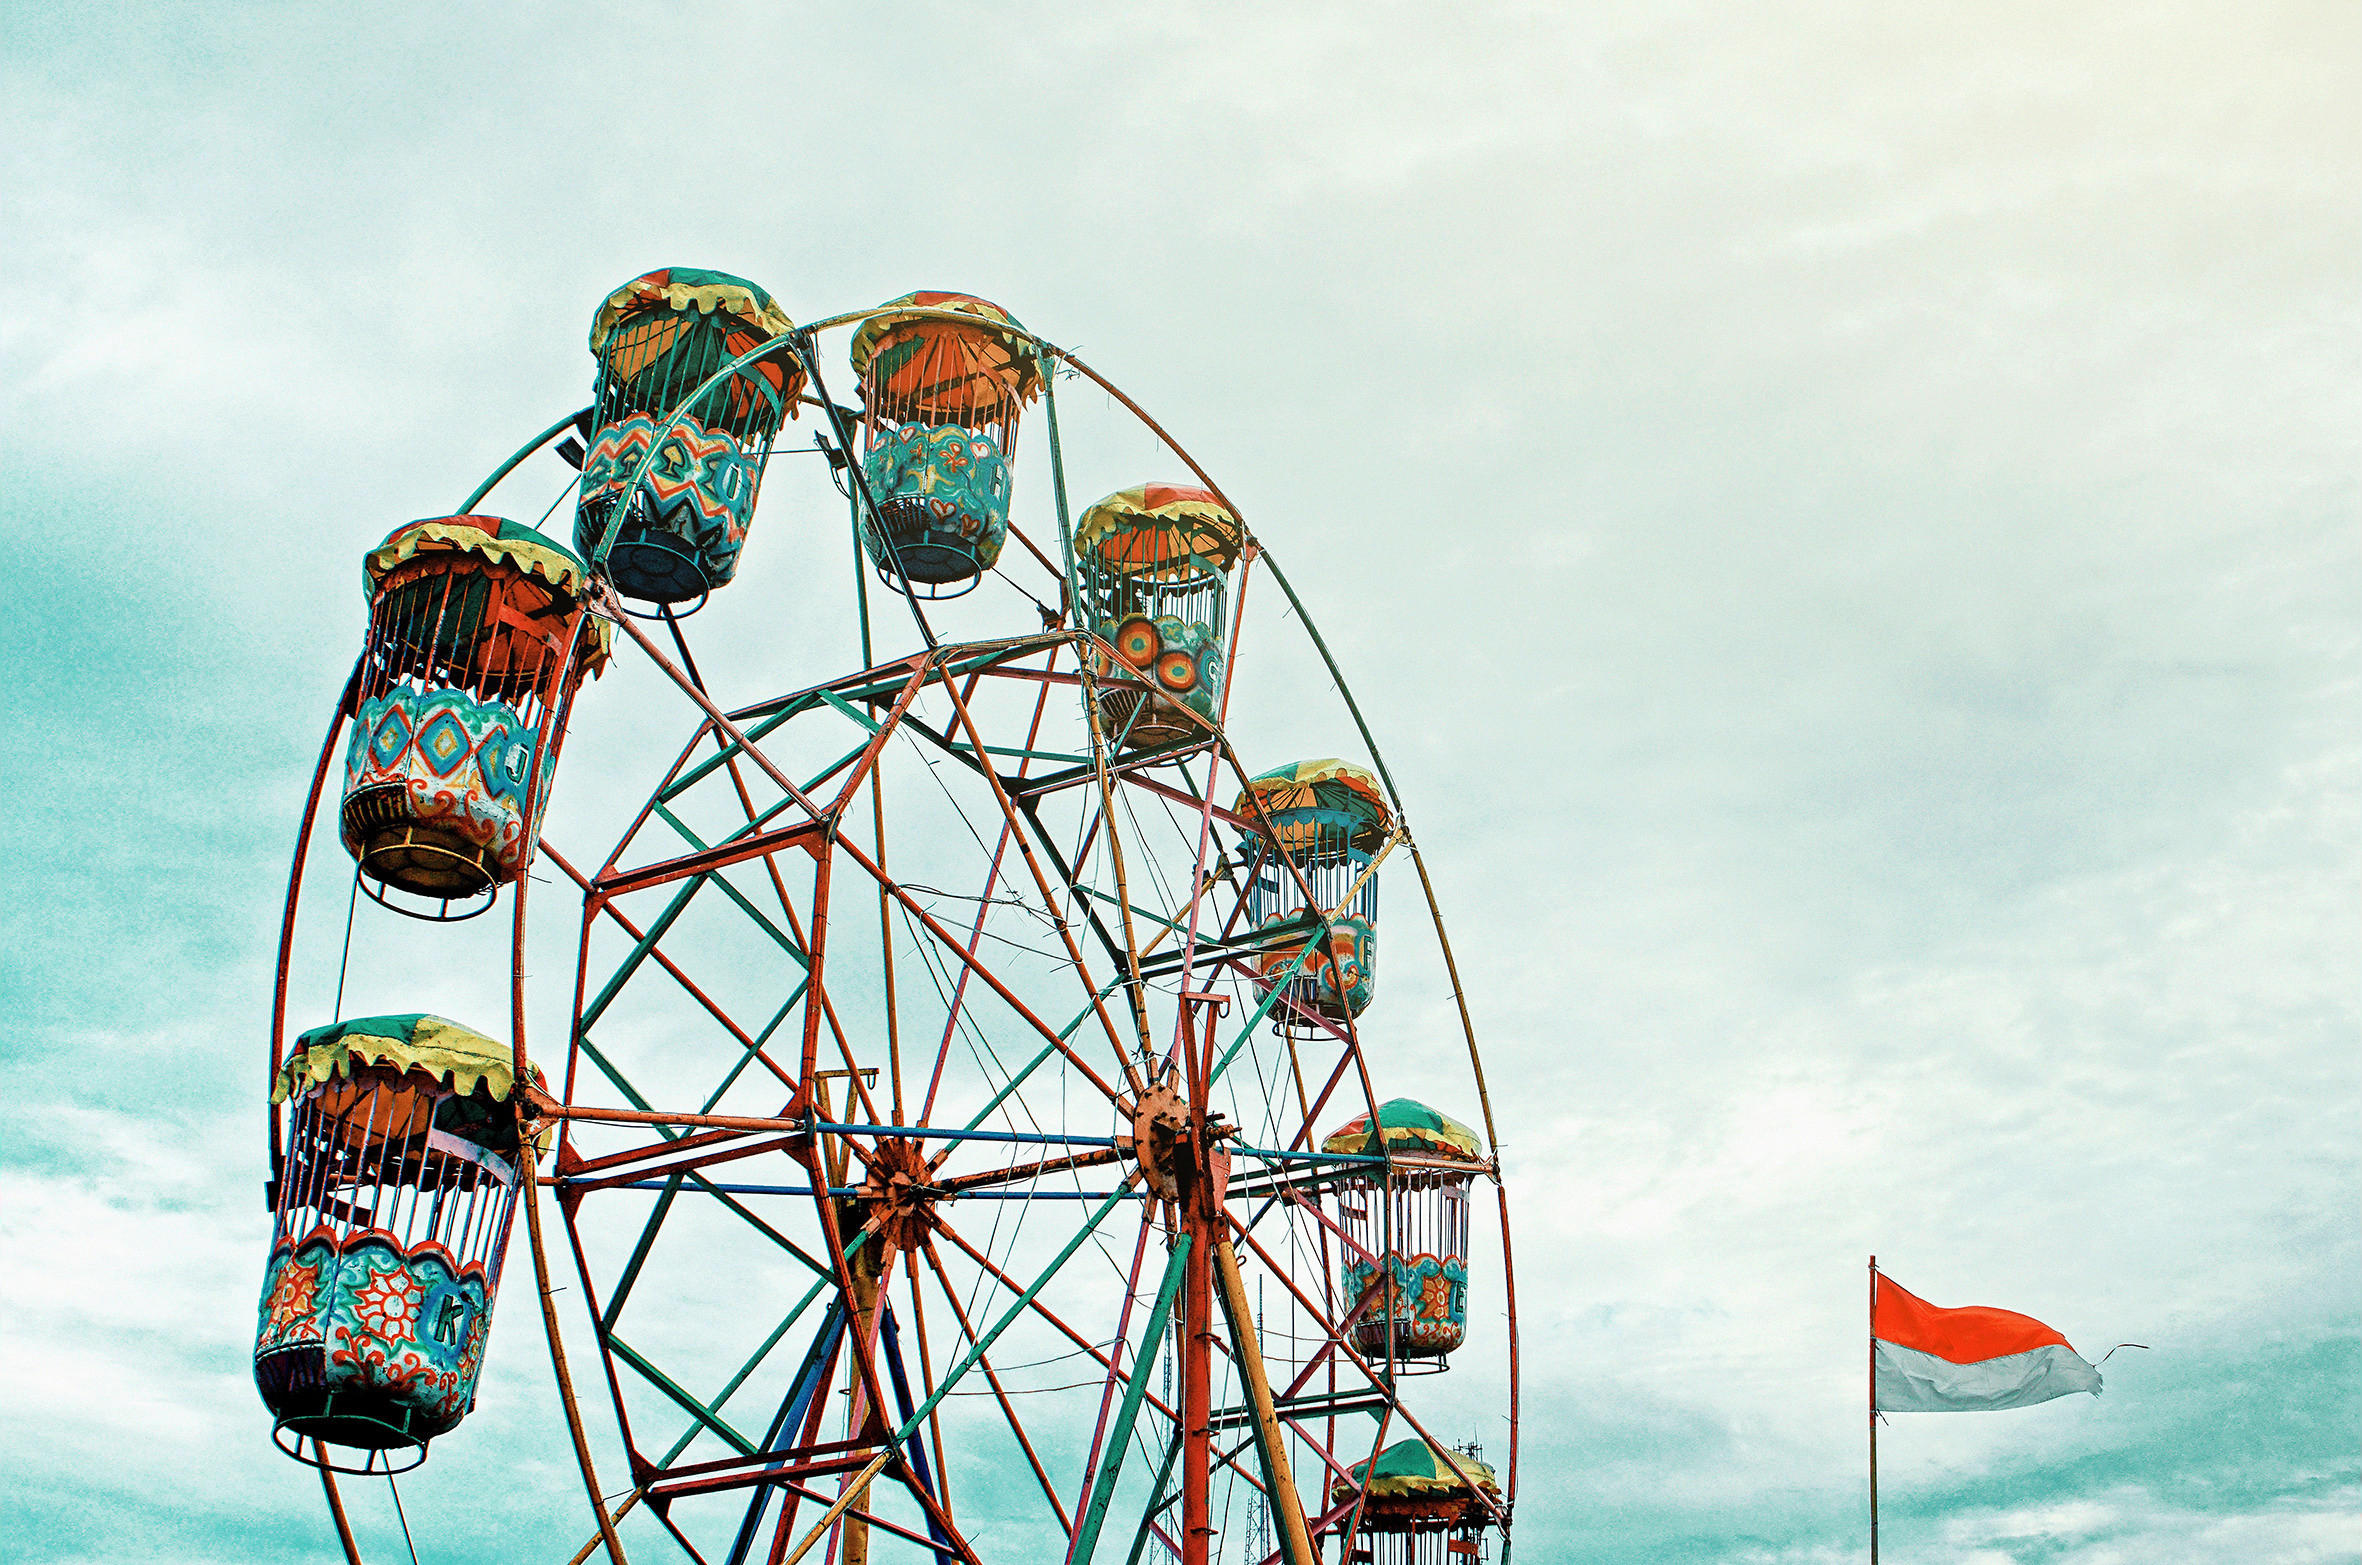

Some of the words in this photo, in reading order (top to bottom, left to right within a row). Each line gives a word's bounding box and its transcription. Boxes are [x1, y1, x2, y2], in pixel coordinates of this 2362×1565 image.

[990, 464, 1005, 502] H
[505, 749, 528, 784] J
[1455, 1281, 1467, 1313] E
[434, 1294, 464, 1346] K
